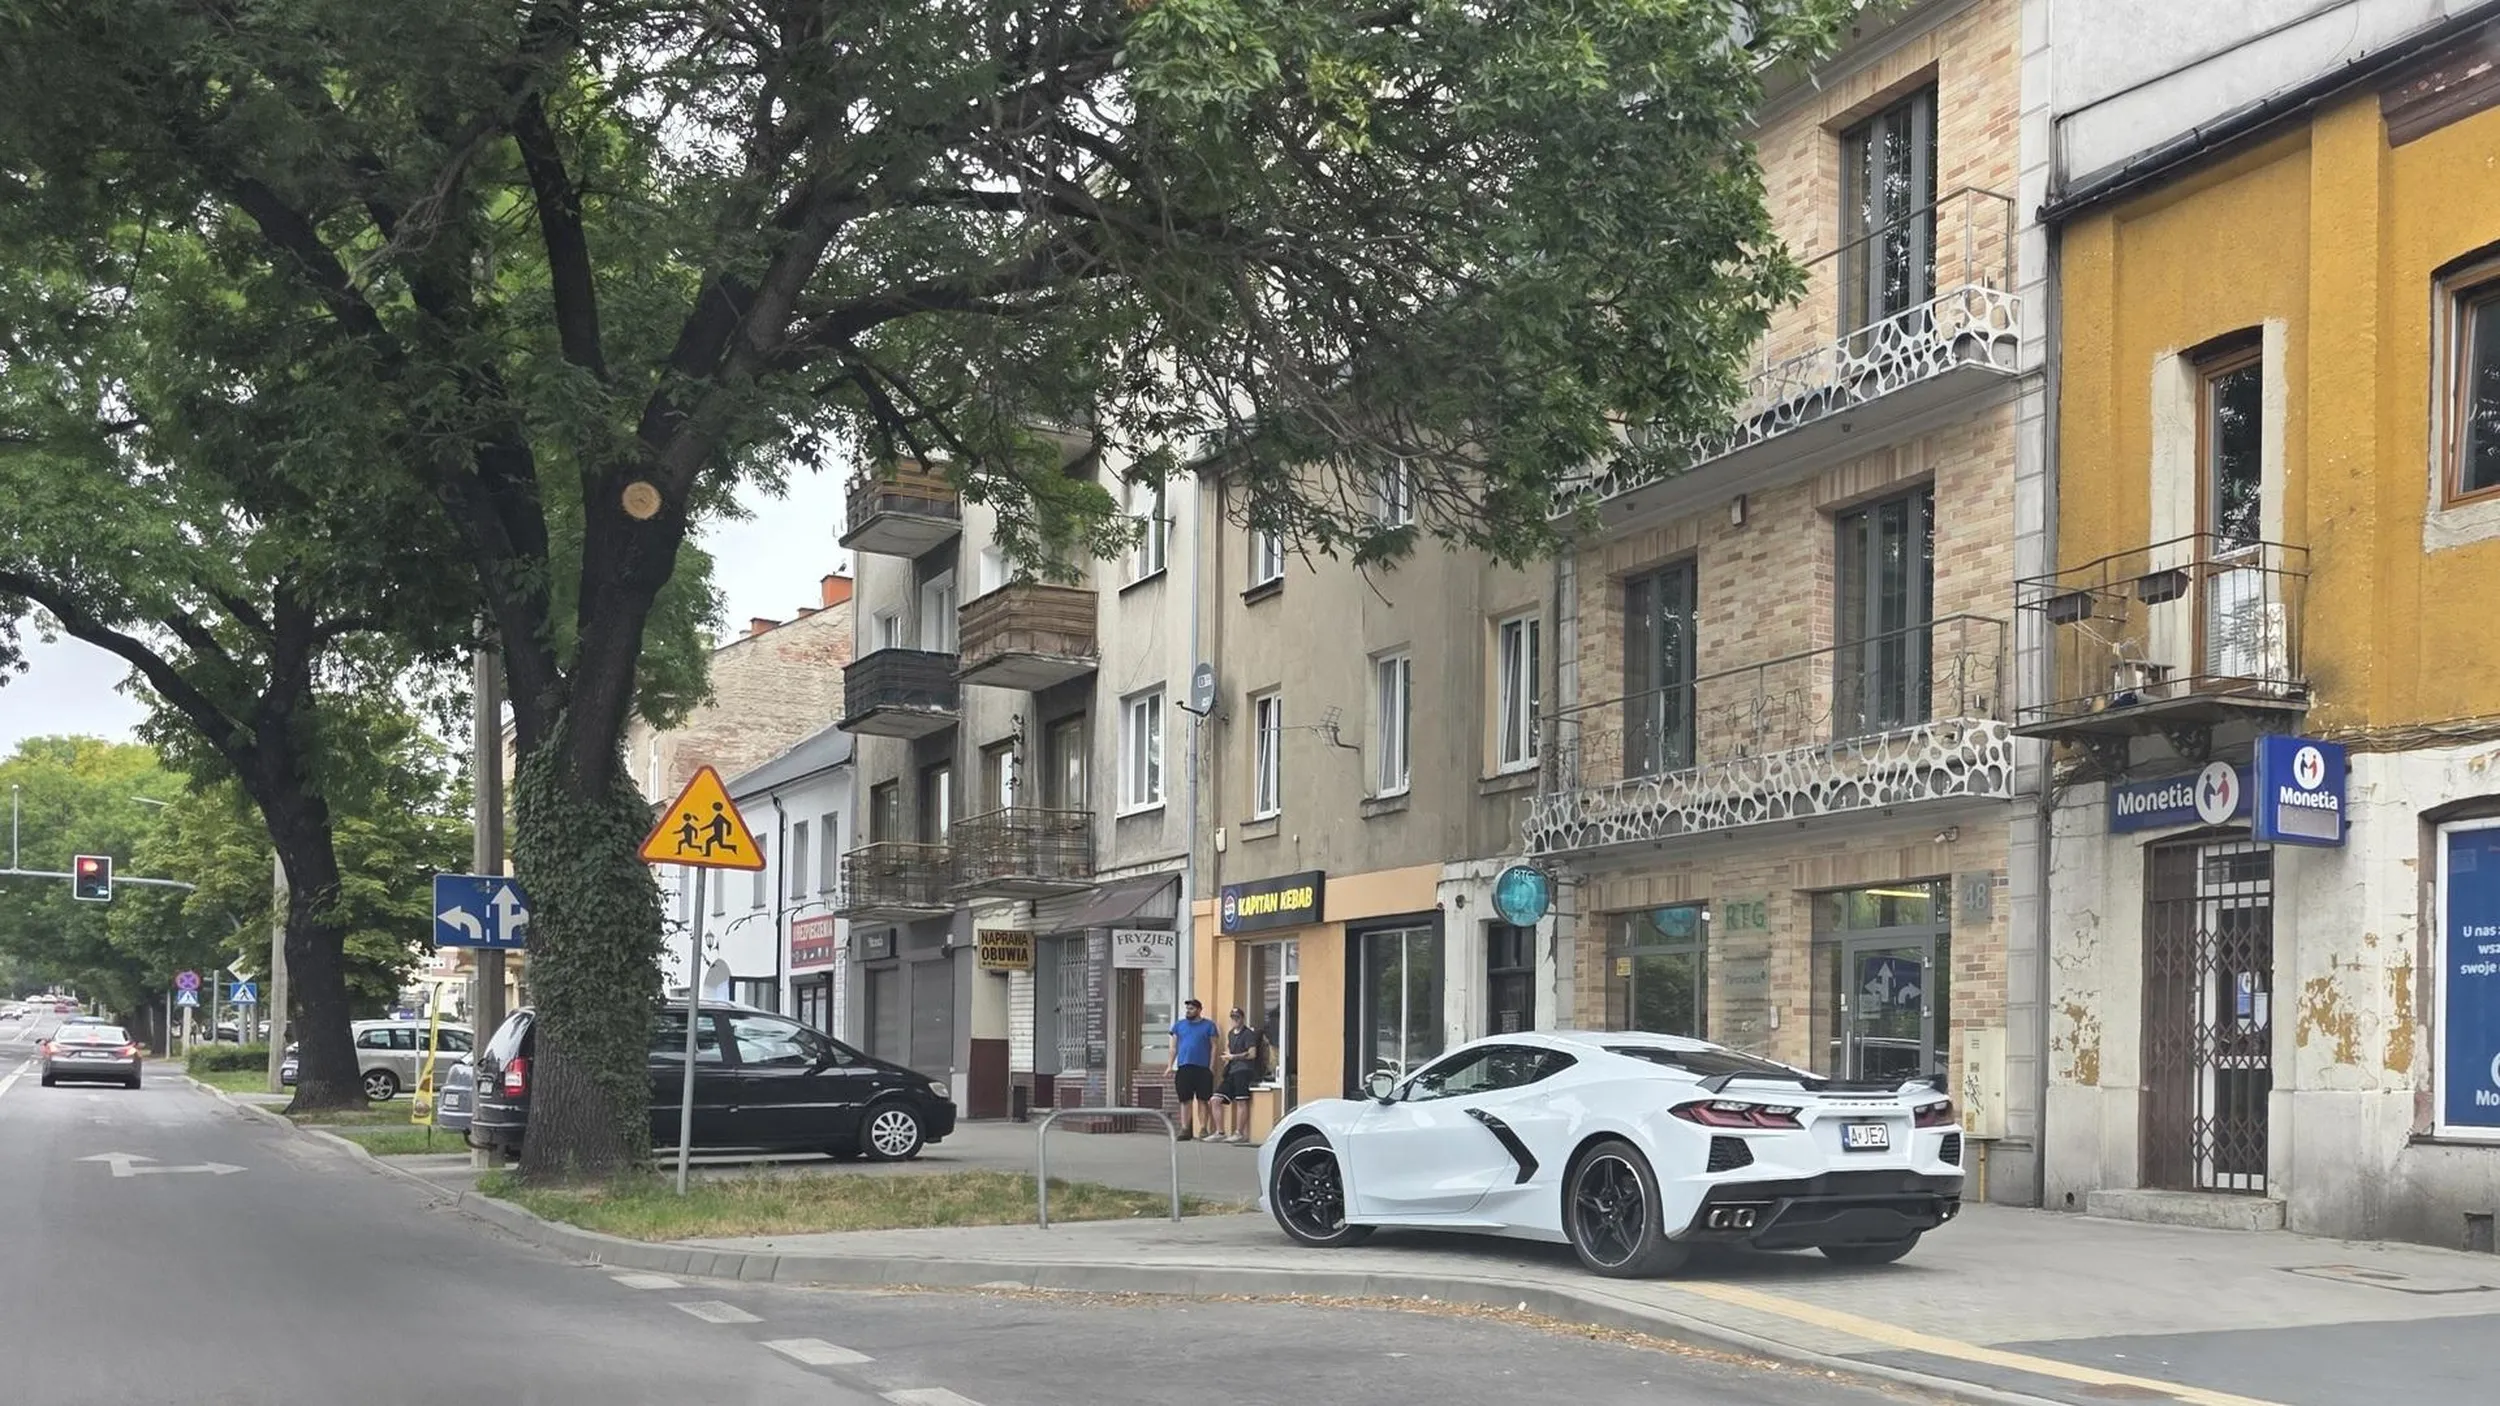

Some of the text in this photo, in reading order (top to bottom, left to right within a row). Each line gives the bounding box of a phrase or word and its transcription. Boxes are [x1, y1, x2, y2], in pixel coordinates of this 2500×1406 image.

[2117, 783, 2194, 816] Monetia
[2280, 786, 2338, 810] Monetia
[1513, 869, 1536, 881] RTG
[1238, 892, 1278, 917] KAPITAN
[1280, 886, 1313, 910] KEBAB
[1963, 883, 1986, 910] 48
[1725, 902, 1767, 930] RTG
[981, 931, 1028, 946] NAPRAWA
[1116, 932, 1174, 947] FRYZJER
[2463, 926, 2472, 937] U
[2475, 926, 2497, 937] nas
[981, 946, 1028, 962] OBUWIA
[2460, 961, 2497, 976] swoje
